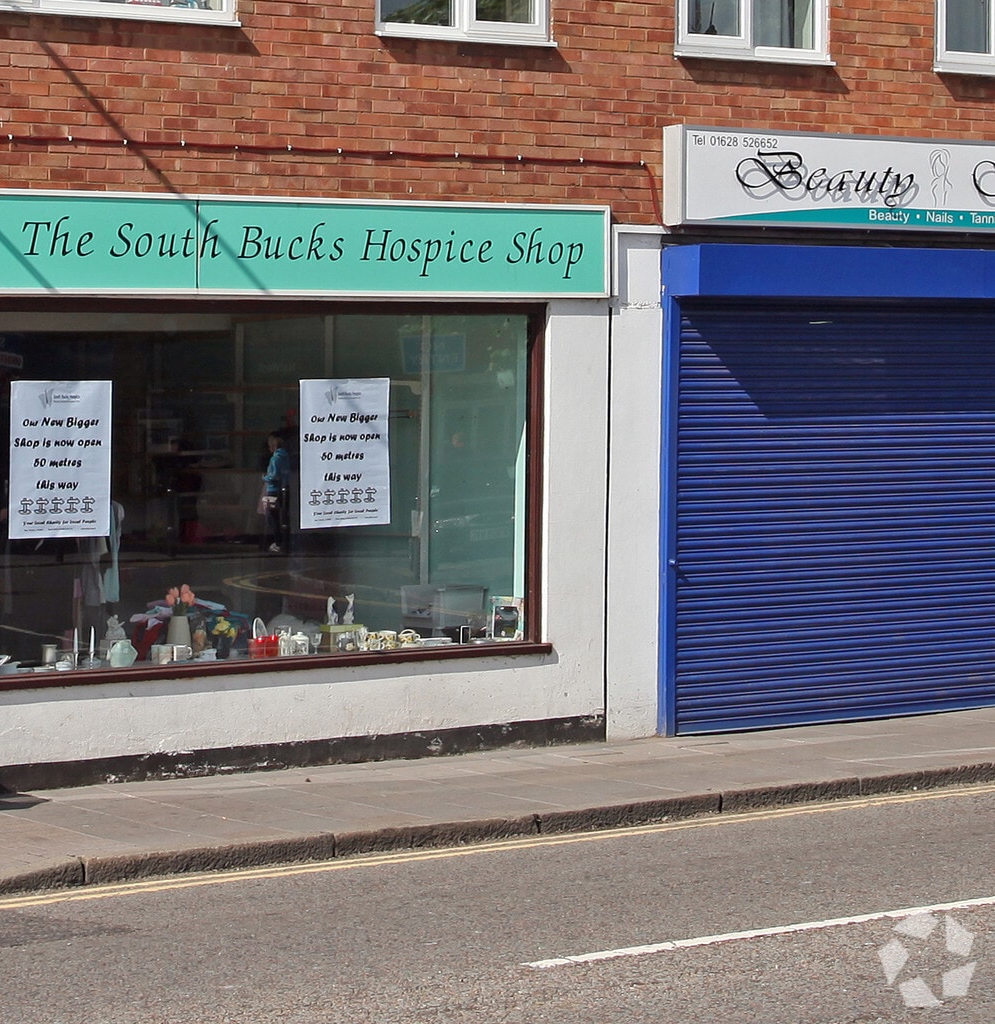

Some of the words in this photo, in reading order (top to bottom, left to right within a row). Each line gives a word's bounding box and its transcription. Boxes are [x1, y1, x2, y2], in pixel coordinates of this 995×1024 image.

[692, 135, 705, 145] Tel
[710, 136, 738, 147] 01628
[743, 137, 778, 148] 526652
[736, 149, 914, 207] Beauty
[869, 209, 910, 224] Beauty
[926, 211, 953, 223] Nails
[22, 216, 94, 257] The
[110, 219, 221, 258] South
[237, 222, 344, 261] Bucks
[360, 229, 494, 277] Hospice
[506, 228, 584, 279] Shop
[22, 418, 39, 427] Our
[41, 416, 64, 427] New
[66, 416, 99, 428] Bigger
[310, 415, 325, 423] Our
[327, 413, 348, 423] New
[349, 413, 378, 423] Bigger
[13, 437, 40, 449] Shop
[42, 437, 51, 448] is
[54, 439, 74, 448] now
[77, 438, 102, 448] open
[303, 433, 326, 444] Shop
[328, 432, 337, 442] is
[339, 434, 358, 442] now
[359, 433, 381, 442] open
[335, 451, 364, 461] metres
[49, 458, 82, 468] metres
[324, 472, 341, 483] this
[343, 473, 363, 482] way
[36, 479, 55, 490] this
[58, 481, 79, 491] way
